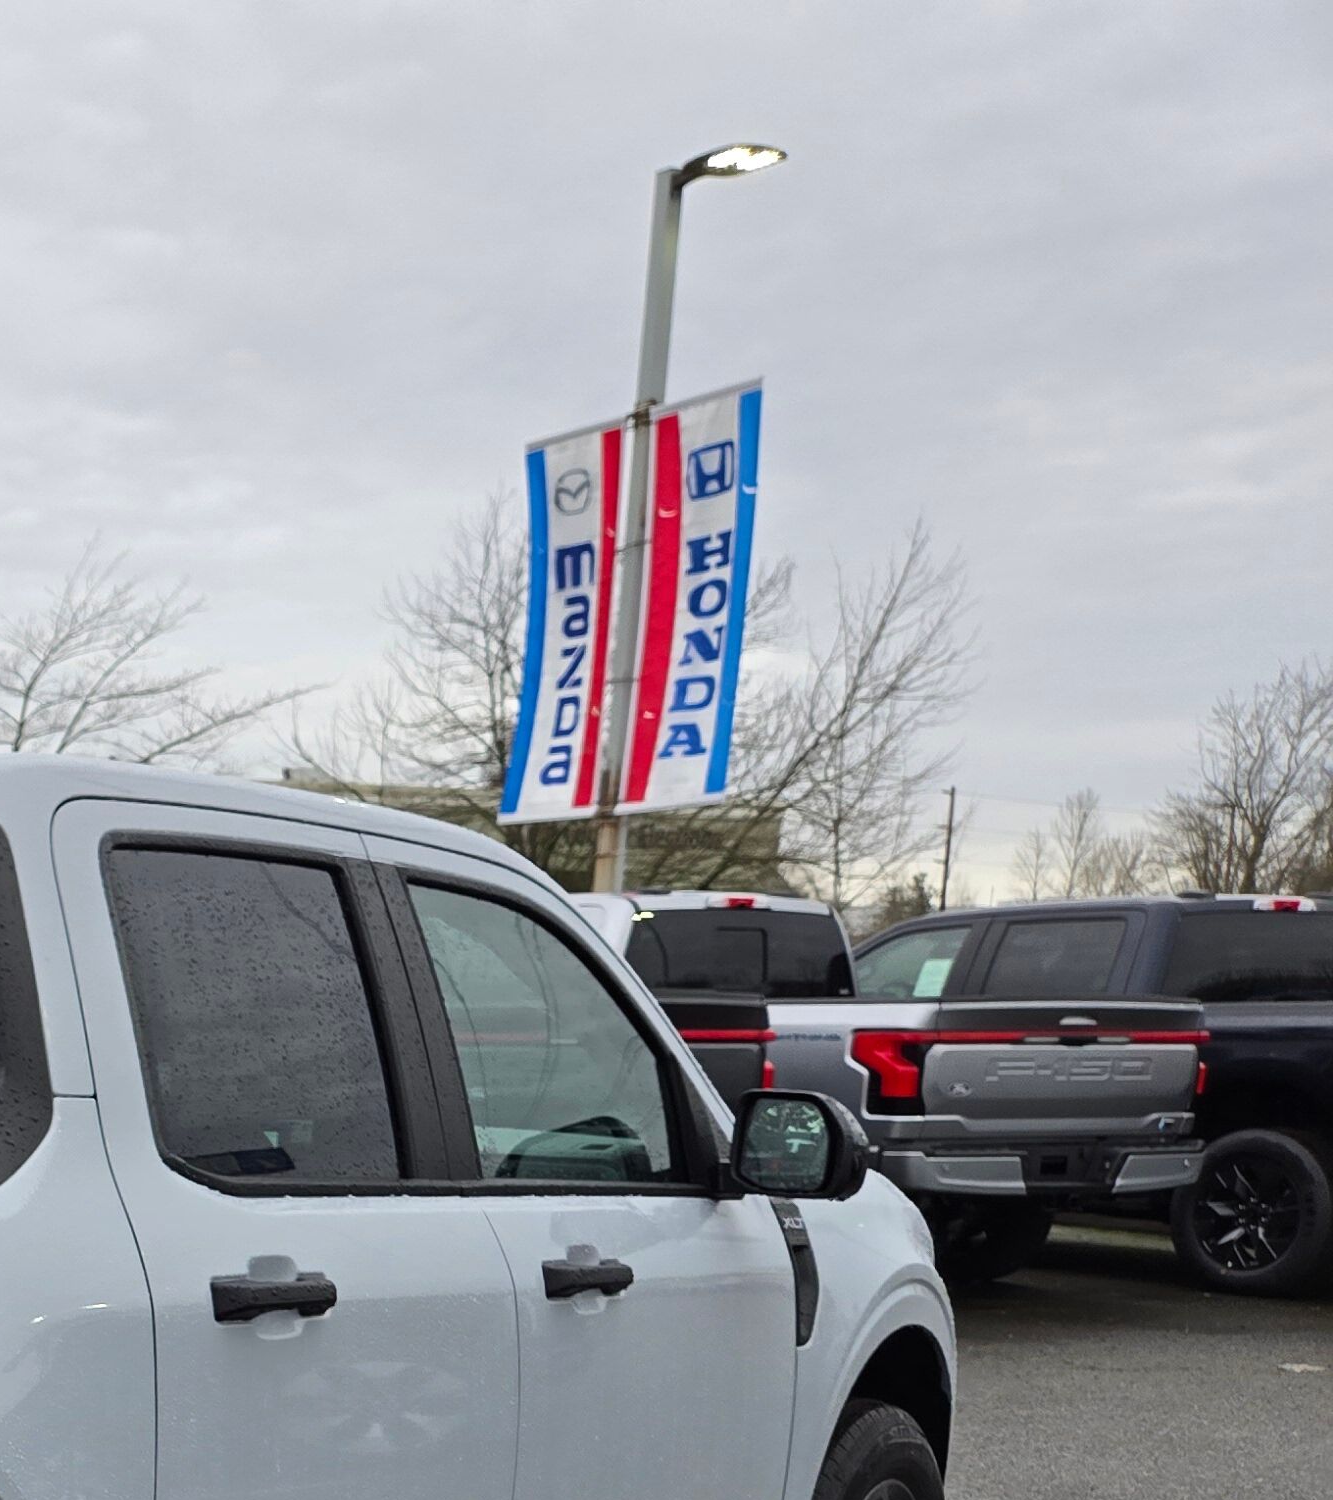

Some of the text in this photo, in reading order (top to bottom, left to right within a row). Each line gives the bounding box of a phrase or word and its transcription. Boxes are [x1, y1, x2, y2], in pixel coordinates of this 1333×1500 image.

[658, 529, 732, 759] HONDA
[985, 1057, 1153, 1082] F-150
[782, 1216, 803, 1230] XLT
